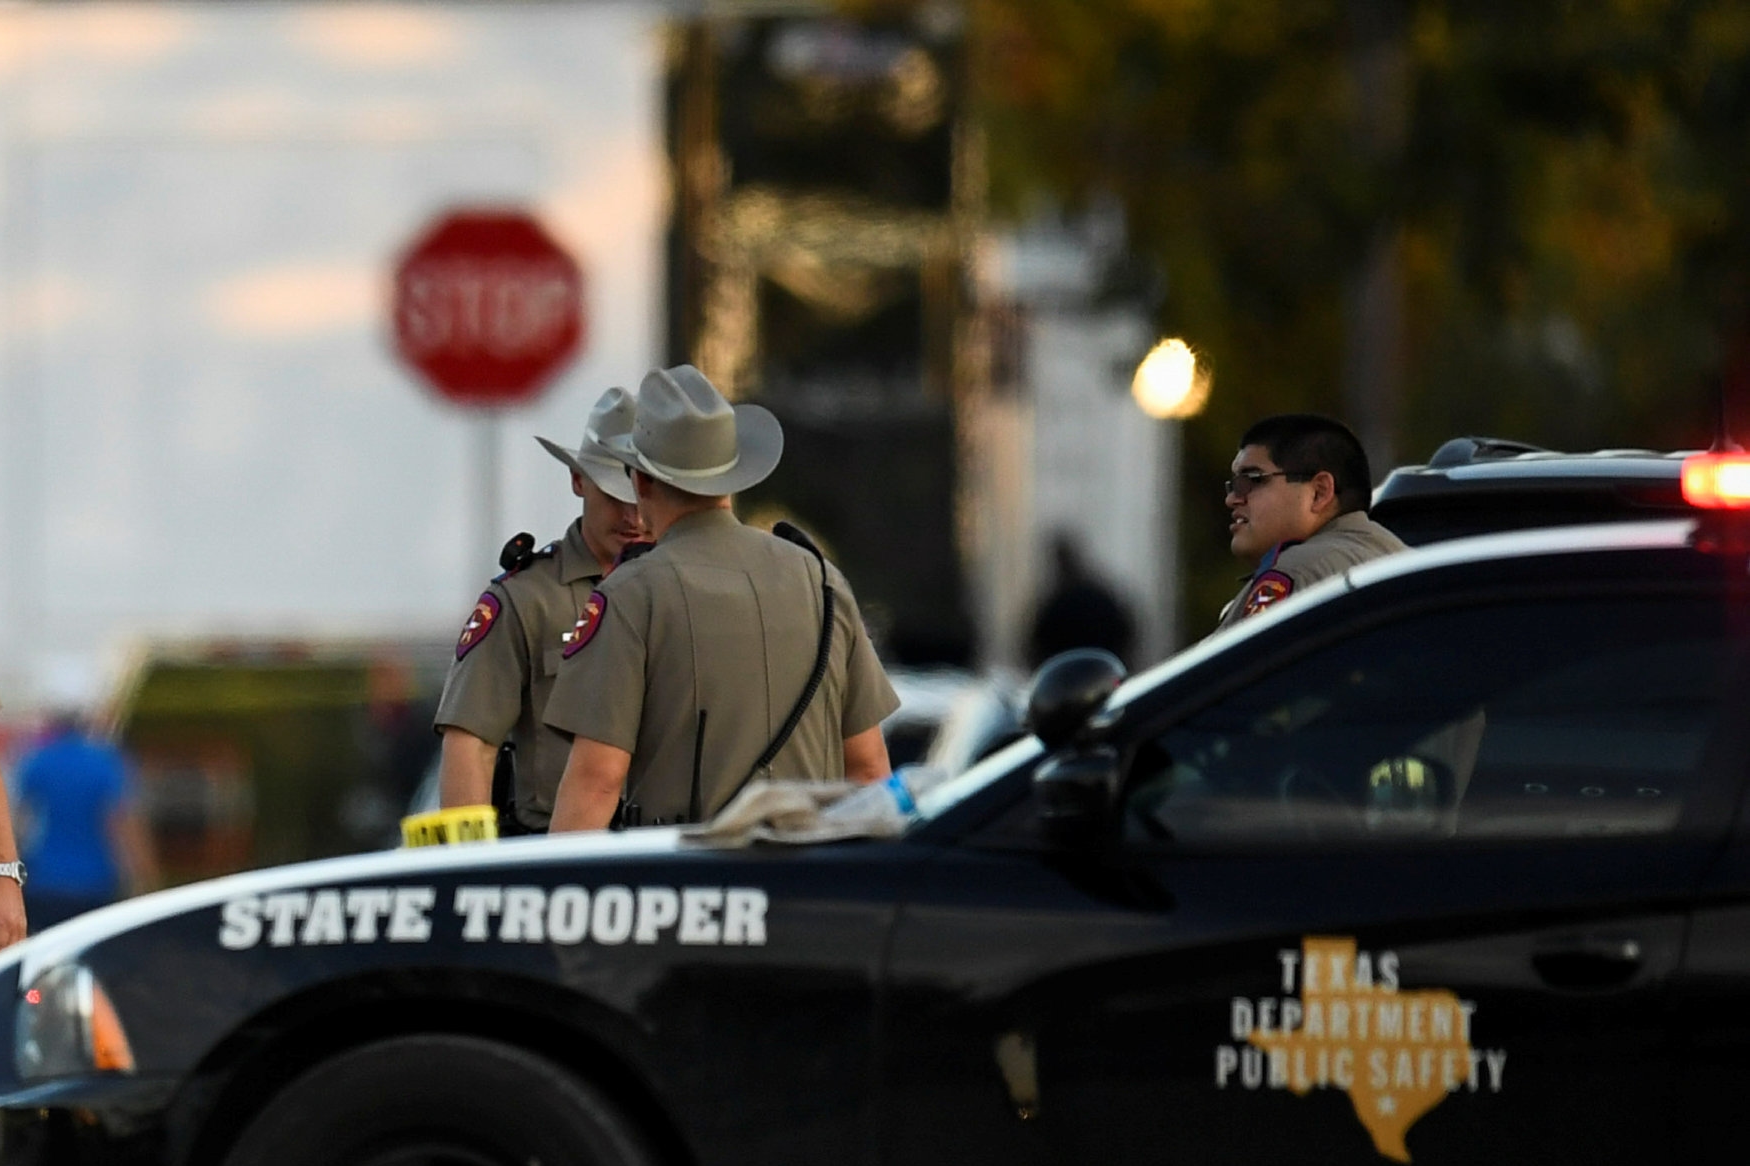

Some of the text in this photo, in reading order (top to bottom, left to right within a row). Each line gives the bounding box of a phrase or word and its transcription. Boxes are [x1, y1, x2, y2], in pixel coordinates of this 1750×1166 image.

[405, 264, 572, 346] STOP
[219, 885, 768, 950] STATE TROOPER
[1279, 948, 1401, 993] TEXAS
[1231, 996, 1477, 1042] DEPARTMENT
[1215, 1044, 1507, 1093] PUBLIC SAFETY
